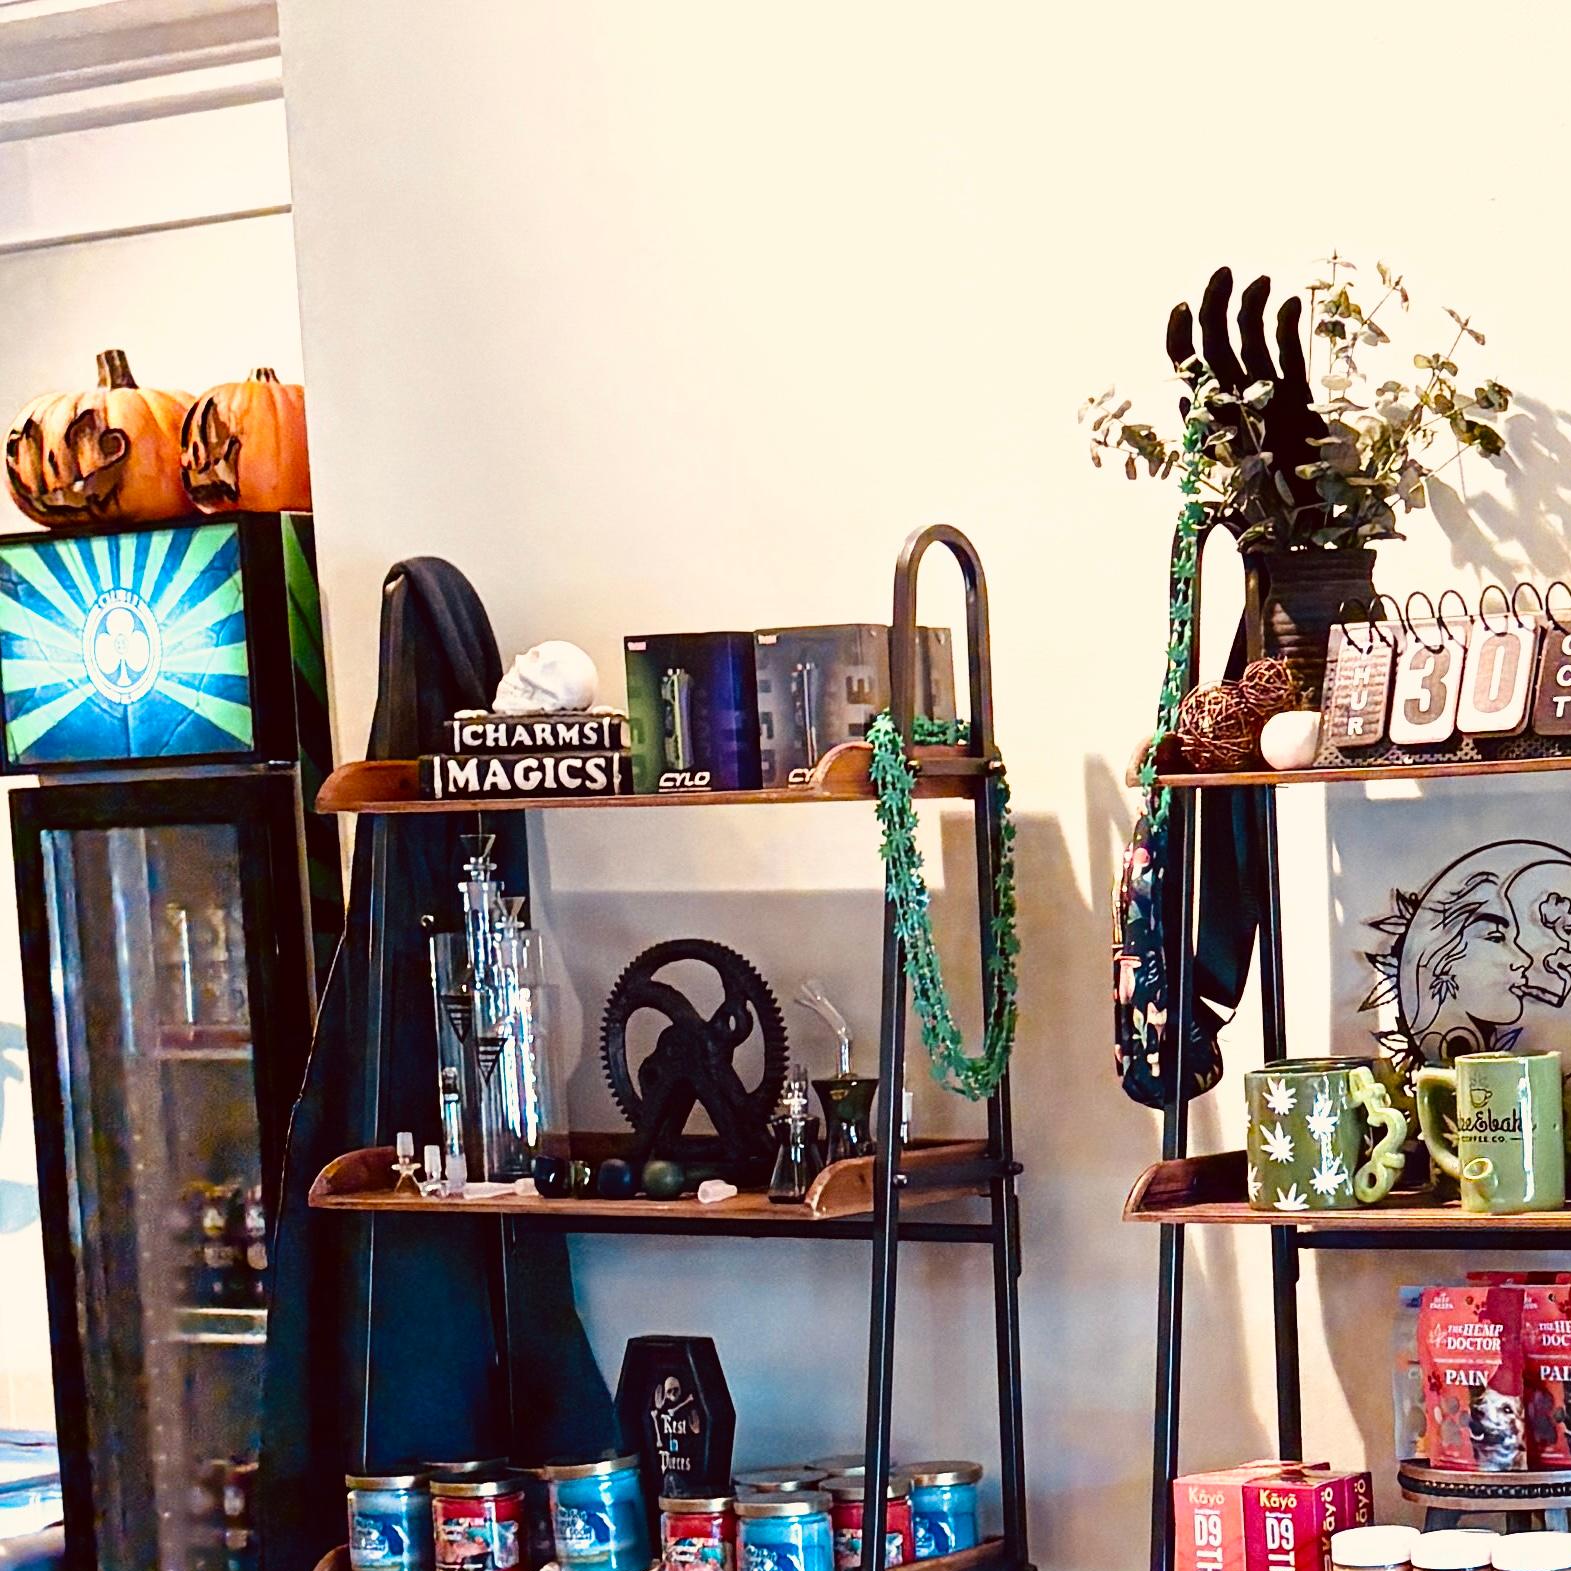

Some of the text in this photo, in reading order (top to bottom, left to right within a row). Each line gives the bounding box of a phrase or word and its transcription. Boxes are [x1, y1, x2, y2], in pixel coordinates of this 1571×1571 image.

[462, 721, 599, 747] CHARMS
[447, 757, 608, 792] MAGICS
[788, 768, 815, 783] CY
[1463, 1323, 1503, 1337] HEMP
[1448, 1337, 1501, 1351] DOCTOR
[1445, 1370, 1489, 1387] PAIN
[1194, 1514, 1222, 1547] D9
[1265, 1517, 1294, 1550] D9
